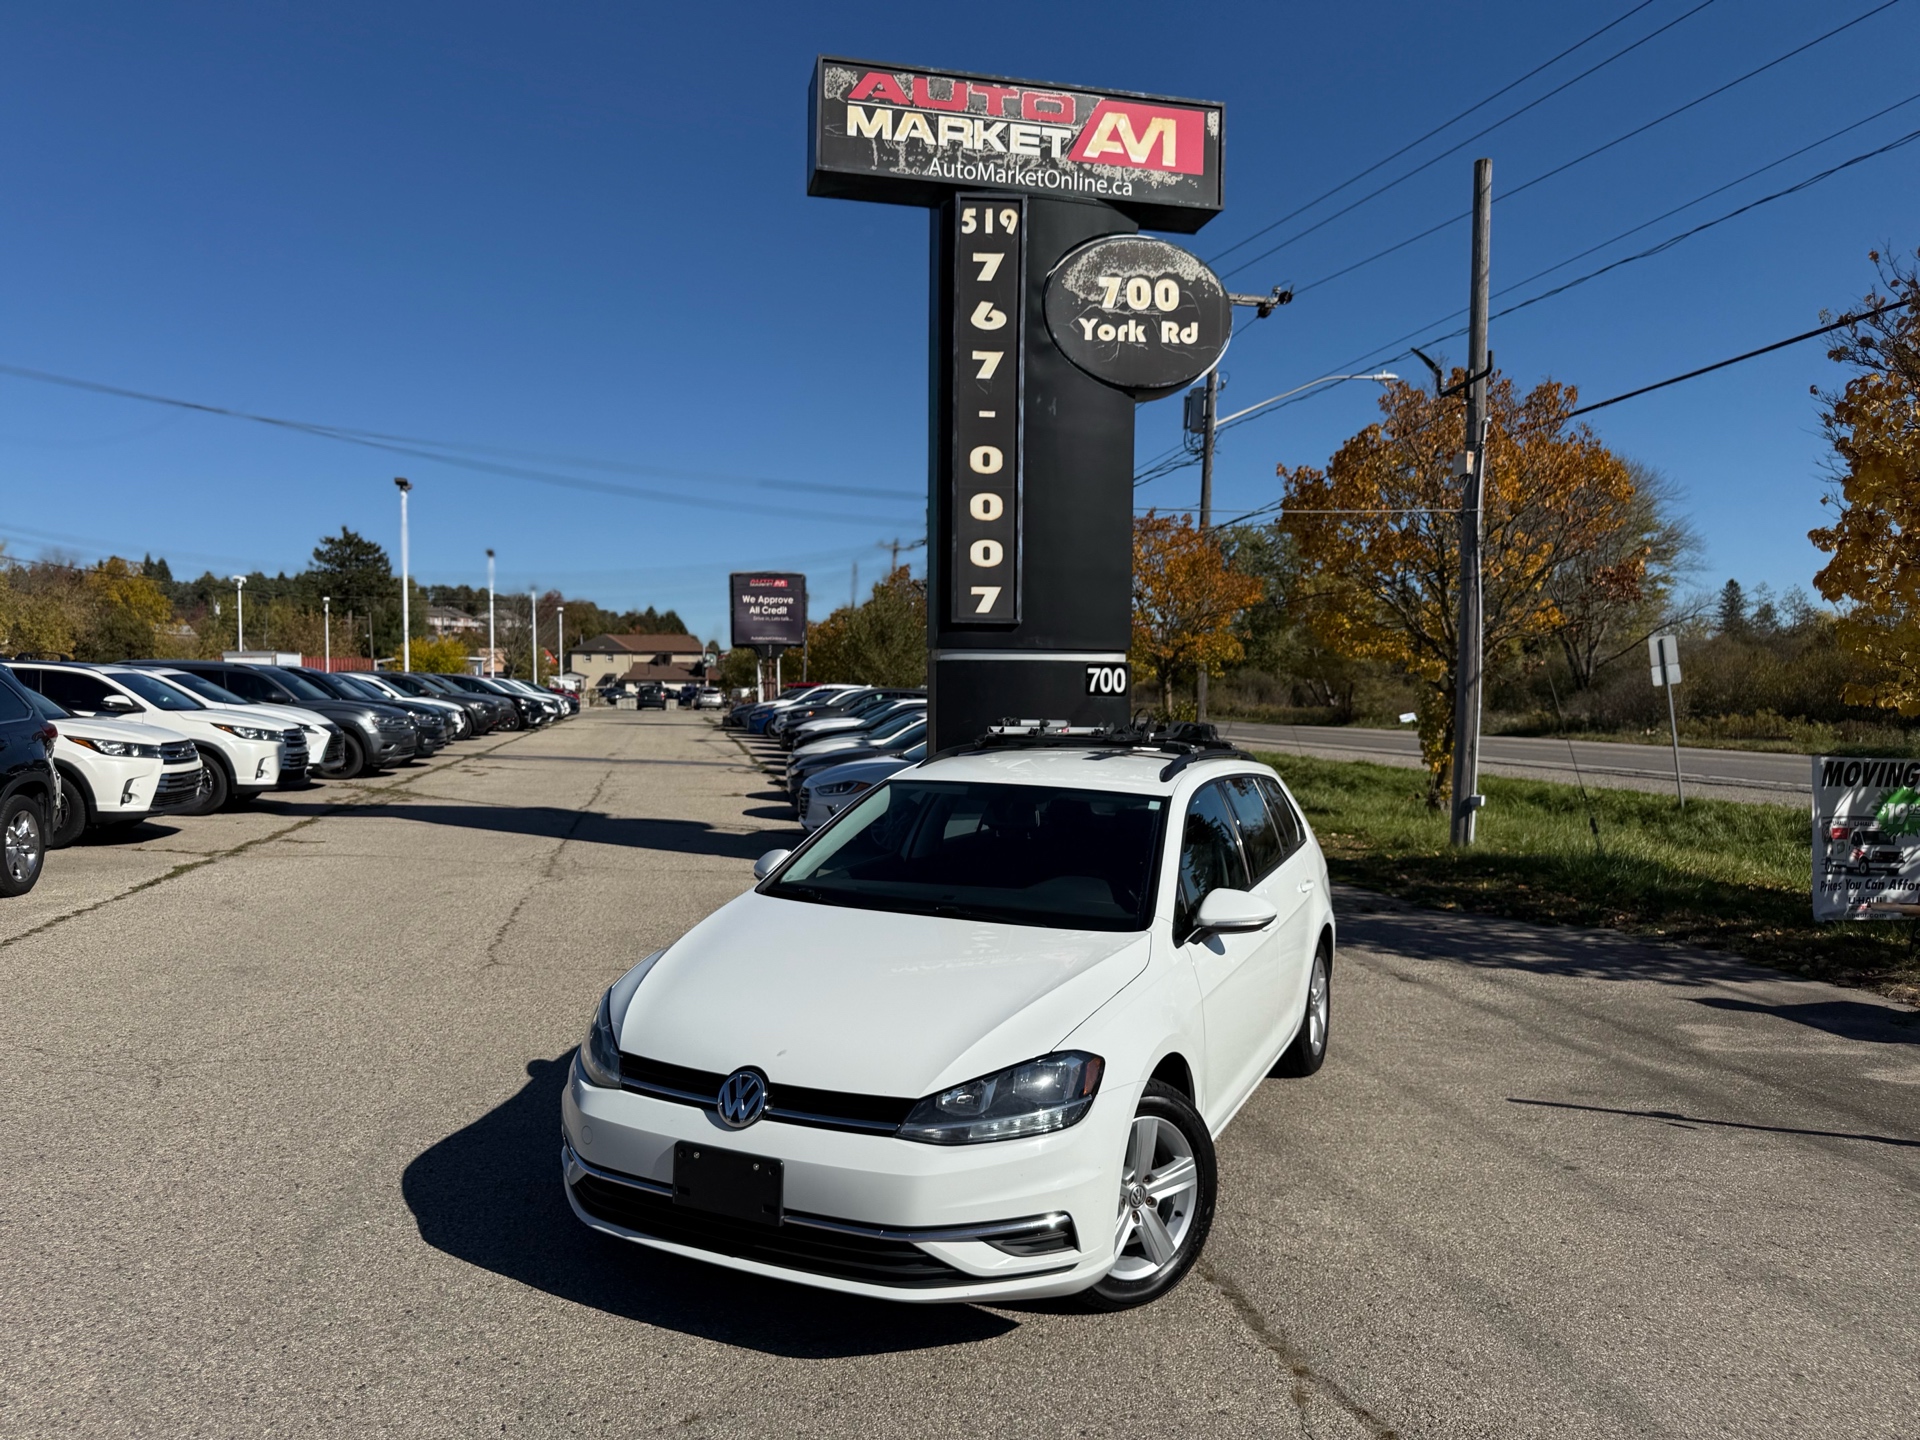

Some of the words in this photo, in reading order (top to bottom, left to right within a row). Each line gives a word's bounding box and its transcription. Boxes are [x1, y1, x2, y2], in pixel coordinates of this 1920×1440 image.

[847, 71, 1077, 125] AUTO
[847, 105, 1072, 159] MARKET
[928, 157, 1133, 197] AutoMarketOnline.ca
[961, 207, 1019, 235] 519
[1098, 276, 1181, 312] 700
[1078, 317, 1147, 343] York
[1160, 320, 1199, 345] Rd
[742, 595, 756, 604] We
[758, 595, 794, 606] Approve
[749, 605, 760, 614] All
[762, 605, 788, 615] Credit
[1086, 667, 1126, 693] 700
[1821, 761, 1920, 788] MOVING
[1820, 880, 1842, 892] Prices
[1845, 879, 1862, 890] You
[1865, 878, 1885, 890] Can
